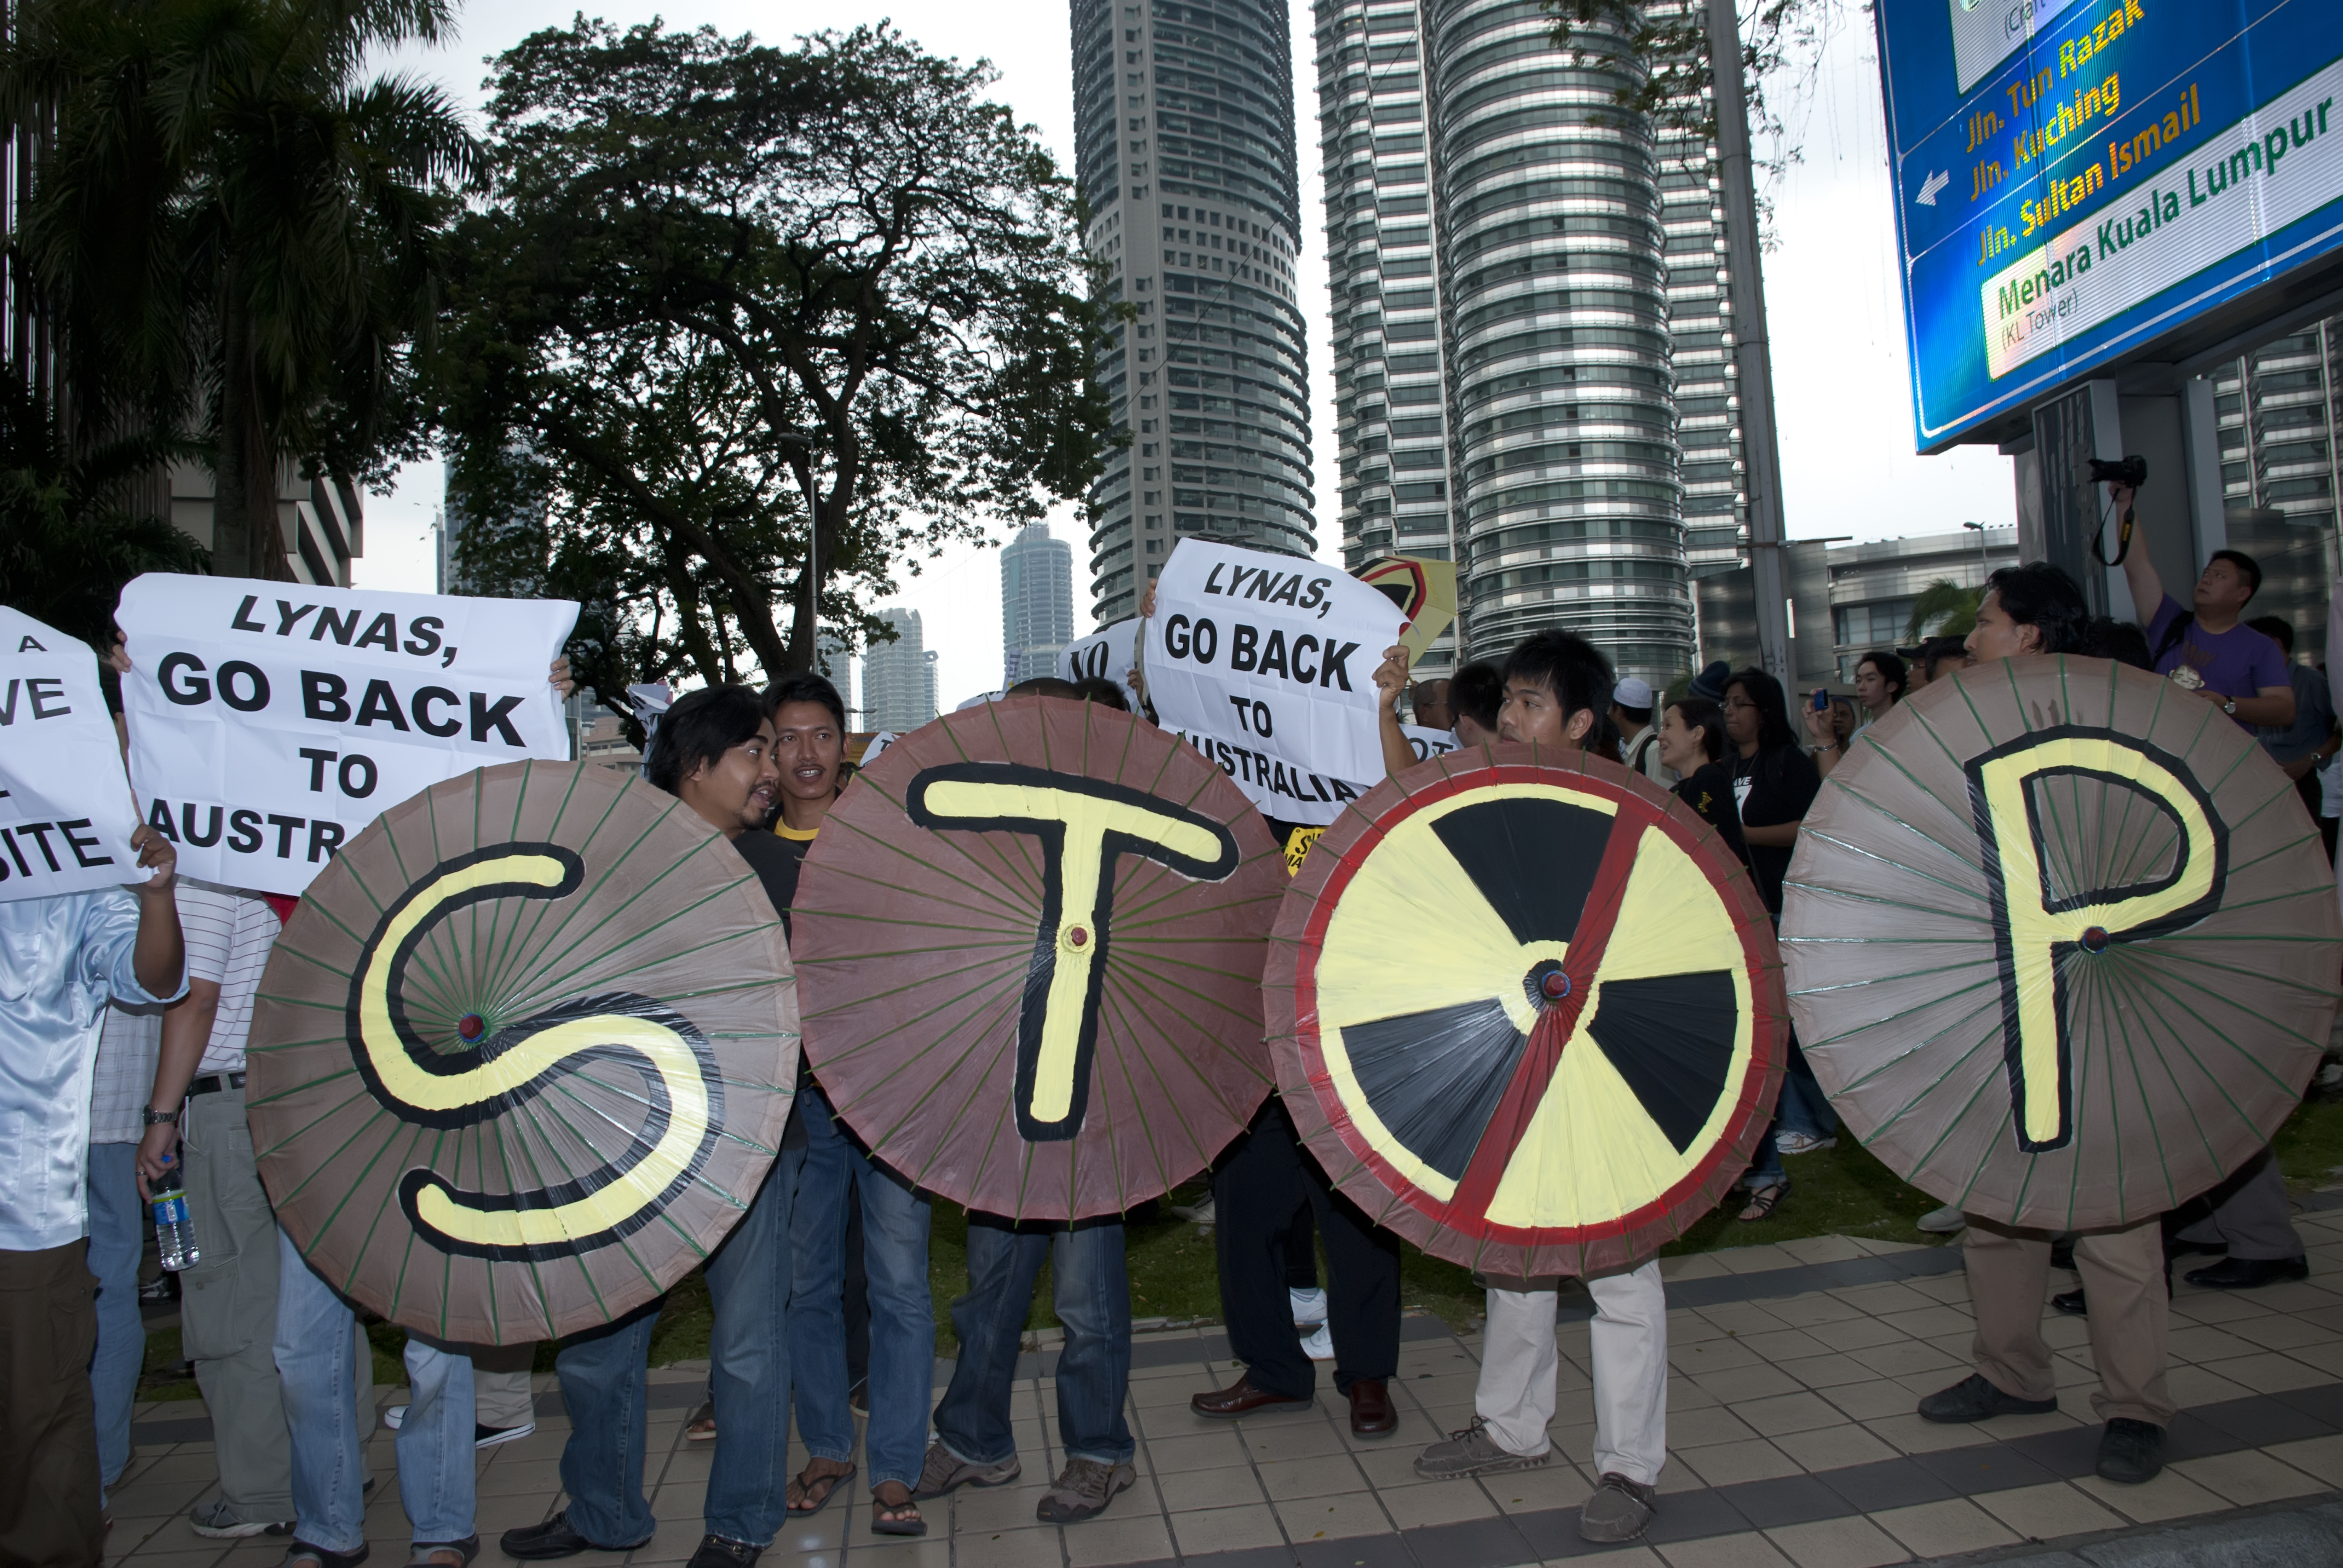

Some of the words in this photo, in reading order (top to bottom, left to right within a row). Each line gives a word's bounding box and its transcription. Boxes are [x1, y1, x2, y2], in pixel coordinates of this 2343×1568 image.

[2005, 0, 2045, 40] (Cra
[1967, 111, 2004, 153] Jln.
[2007, 66, 2052, 117] Tun
[2059, 0, 2145, 79] Razak
[1971, 159, 2008, 201] Jln.
[2014, 72, 2119, 170] Kuching
[1978, 225, 2016, 266] Jln.
[2020, 163, 2103, 237] Sultan
[2109, 83, 2200, 180] Ismail
[1999, 245, 2091, 319] Menara
[2098, 189, 2180, 261] Kuala
[2187, 96, 2332, 208] Lumpur
[2002, 322, 2024, 351] (KL
[2026, 288, 2078, 334] Tower)
[1204, 562, 1332, 619] LYNAS,
[18, 635, 48, 652] A
[231, 595, 458, 668] LYNAS,
[1069, 641, 1109, 682] NO
[1165, 614, 1217, 664] GO
[1231, 623, 1361, 692] BACK
[158, 652, 270, 712] GO
[301, 669, 527, 747] BACK
[1229, 695, 1273, 738] TO
[299, 747, 378, 799] TO
[1177, 731, 1359, 802] USTRALIA
[149, 798, 367, 863] AUSTR
[906, 761, 1240, 1142] T
[1964, 723, 2230, 1154] P
[345, 841, 726, 1262] S
